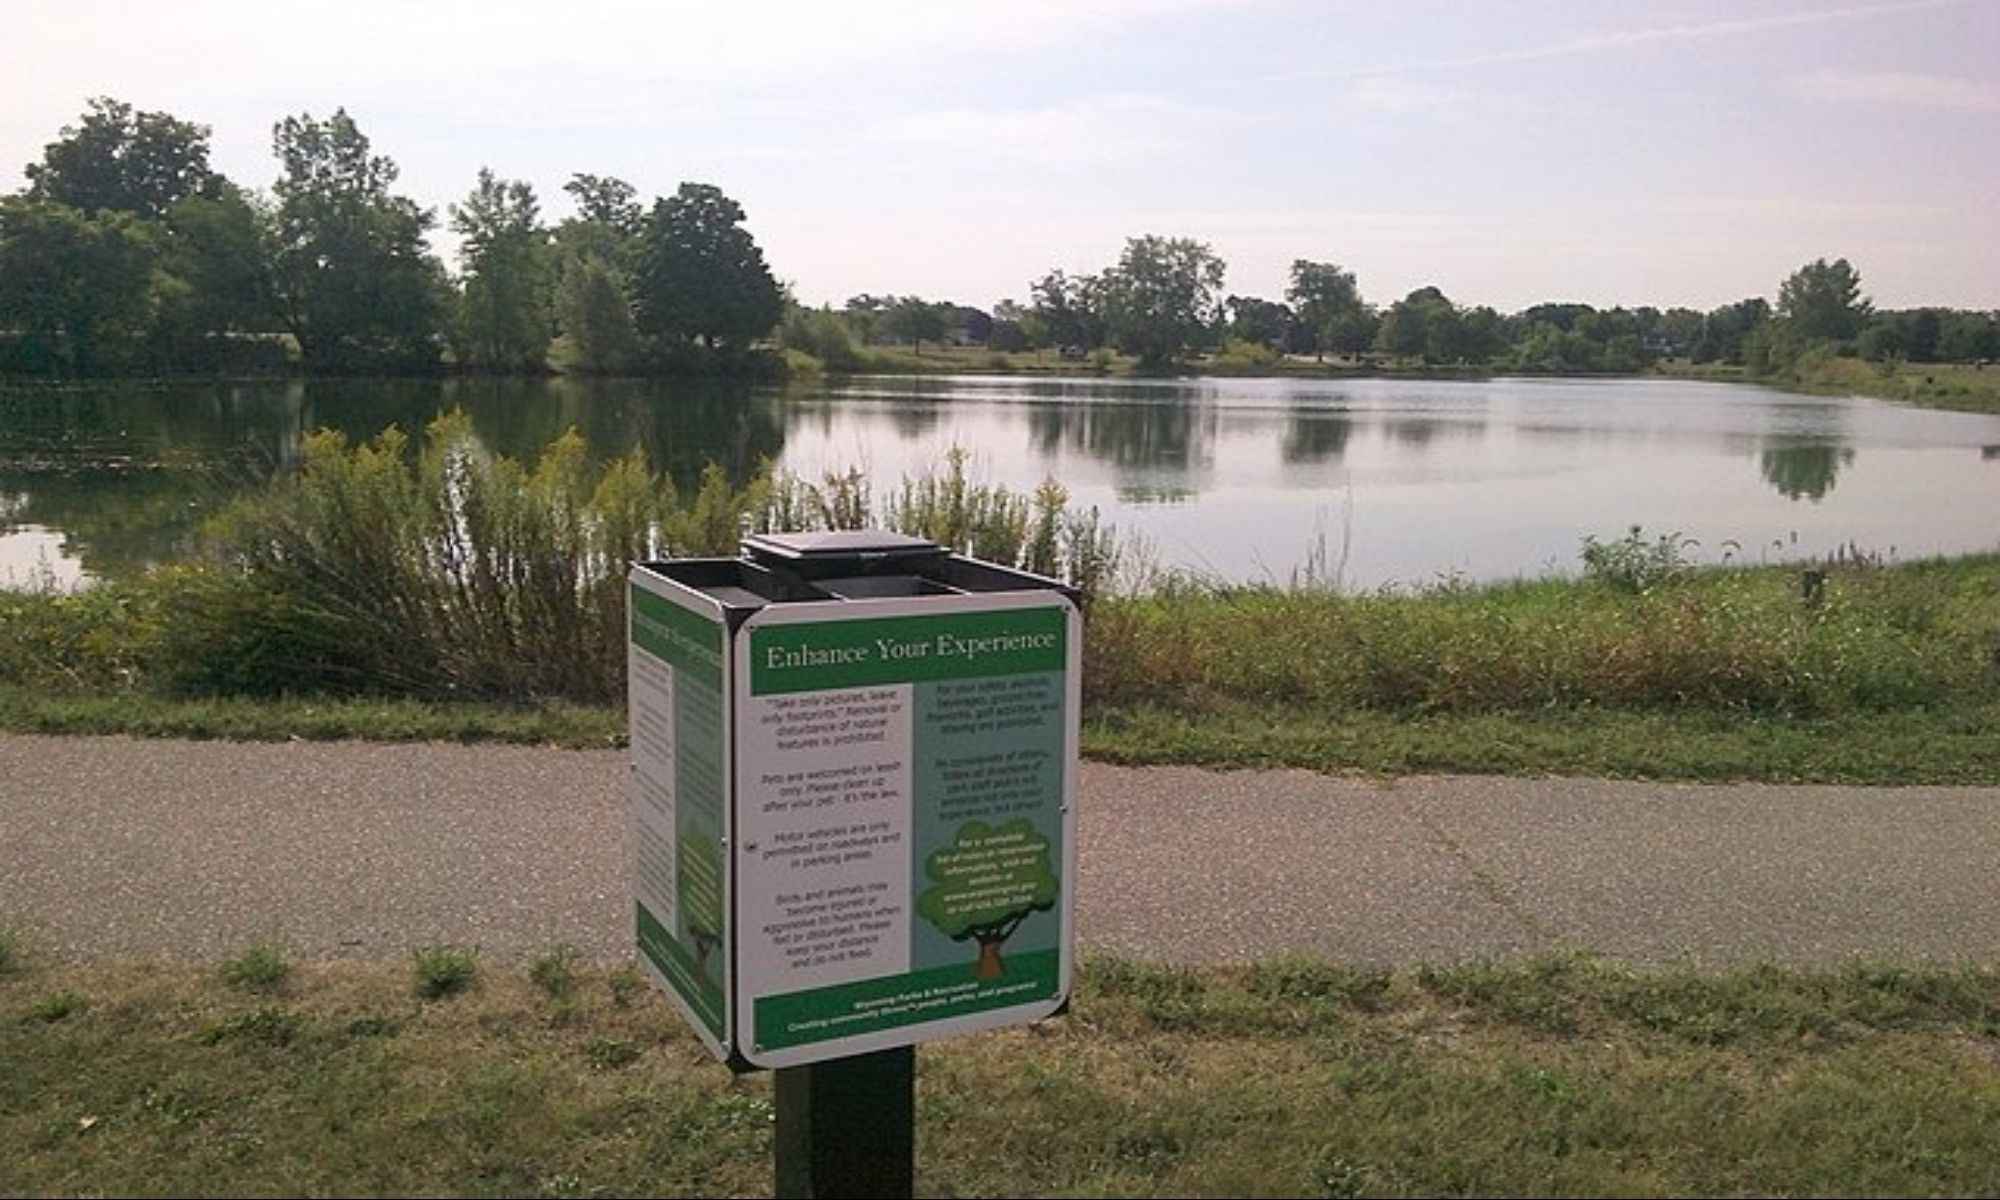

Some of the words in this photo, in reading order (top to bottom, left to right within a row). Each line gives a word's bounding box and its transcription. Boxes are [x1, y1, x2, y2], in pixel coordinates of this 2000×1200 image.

[766, 643, 869, 669] Enhance
[874, 638, 931, 660] Your
[936, 631, 1057, 658] Experience
[787, 772, 804, 782] are
[806, 782, 839, 792] Please
[860, 789, 877, 800] the
[850, 824, 867, 834] are
[881, 832, 901, 843] and
[805, 889, 824, 901] and
[838, 935, 879, 948] distance
